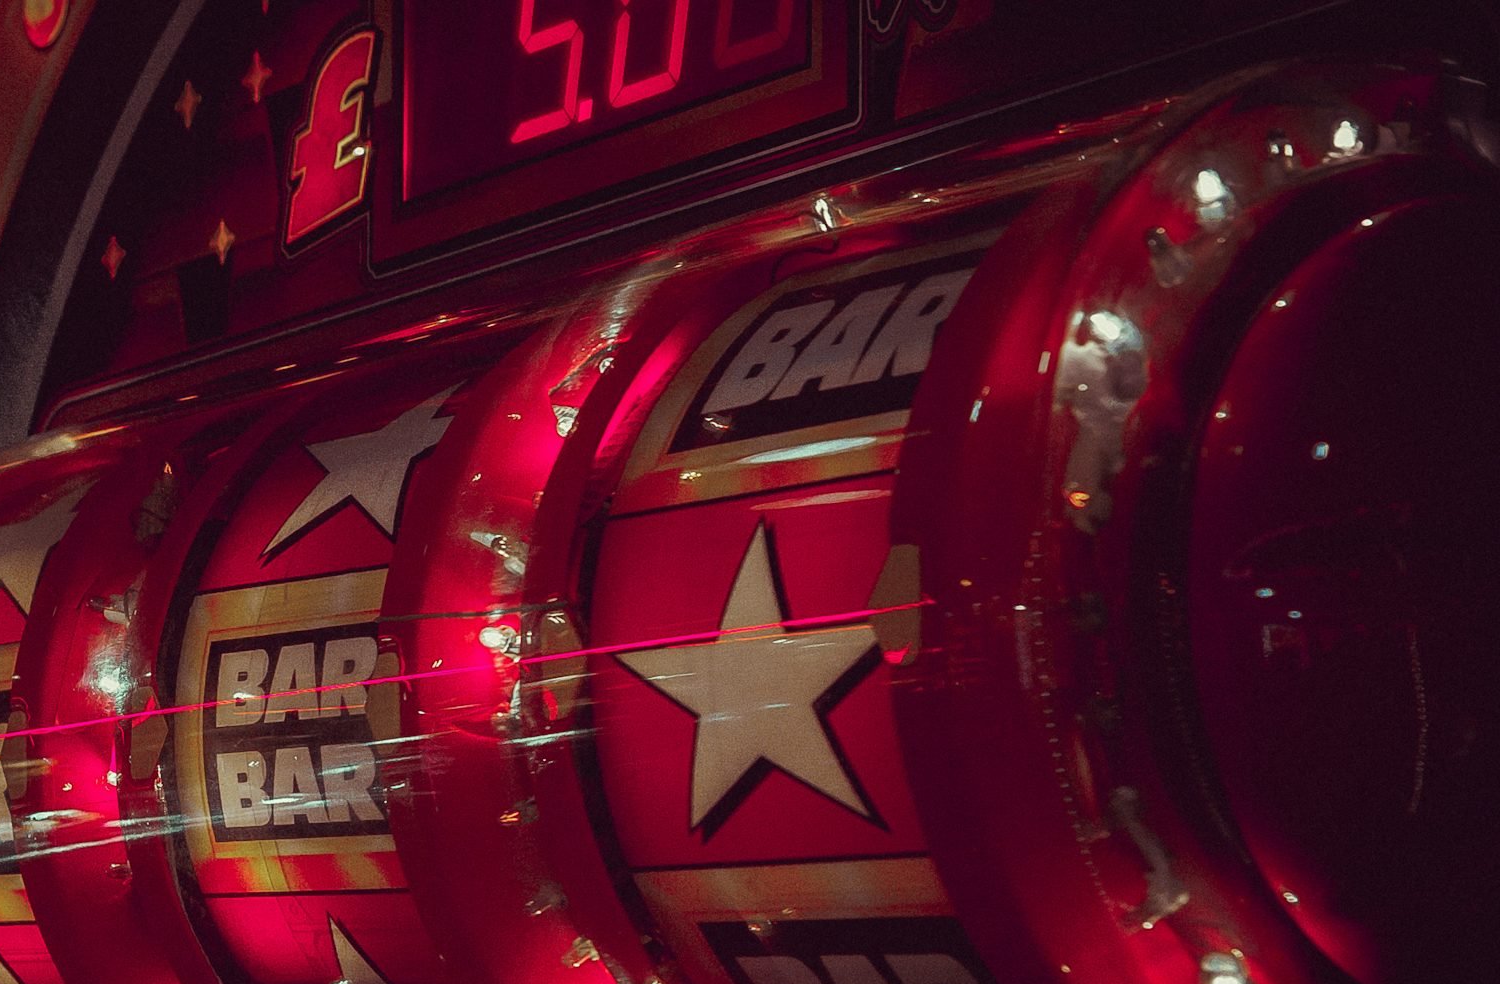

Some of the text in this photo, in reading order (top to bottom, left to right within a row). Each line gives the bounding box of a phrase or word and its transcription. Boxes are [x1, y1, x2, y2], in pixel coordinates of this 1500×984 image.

[286, 31, 376, 244] £
[701, 266, 977, 414] BAR
[216, 636, 378, 728] BAR
[215, 743, 385, 828] BAR
